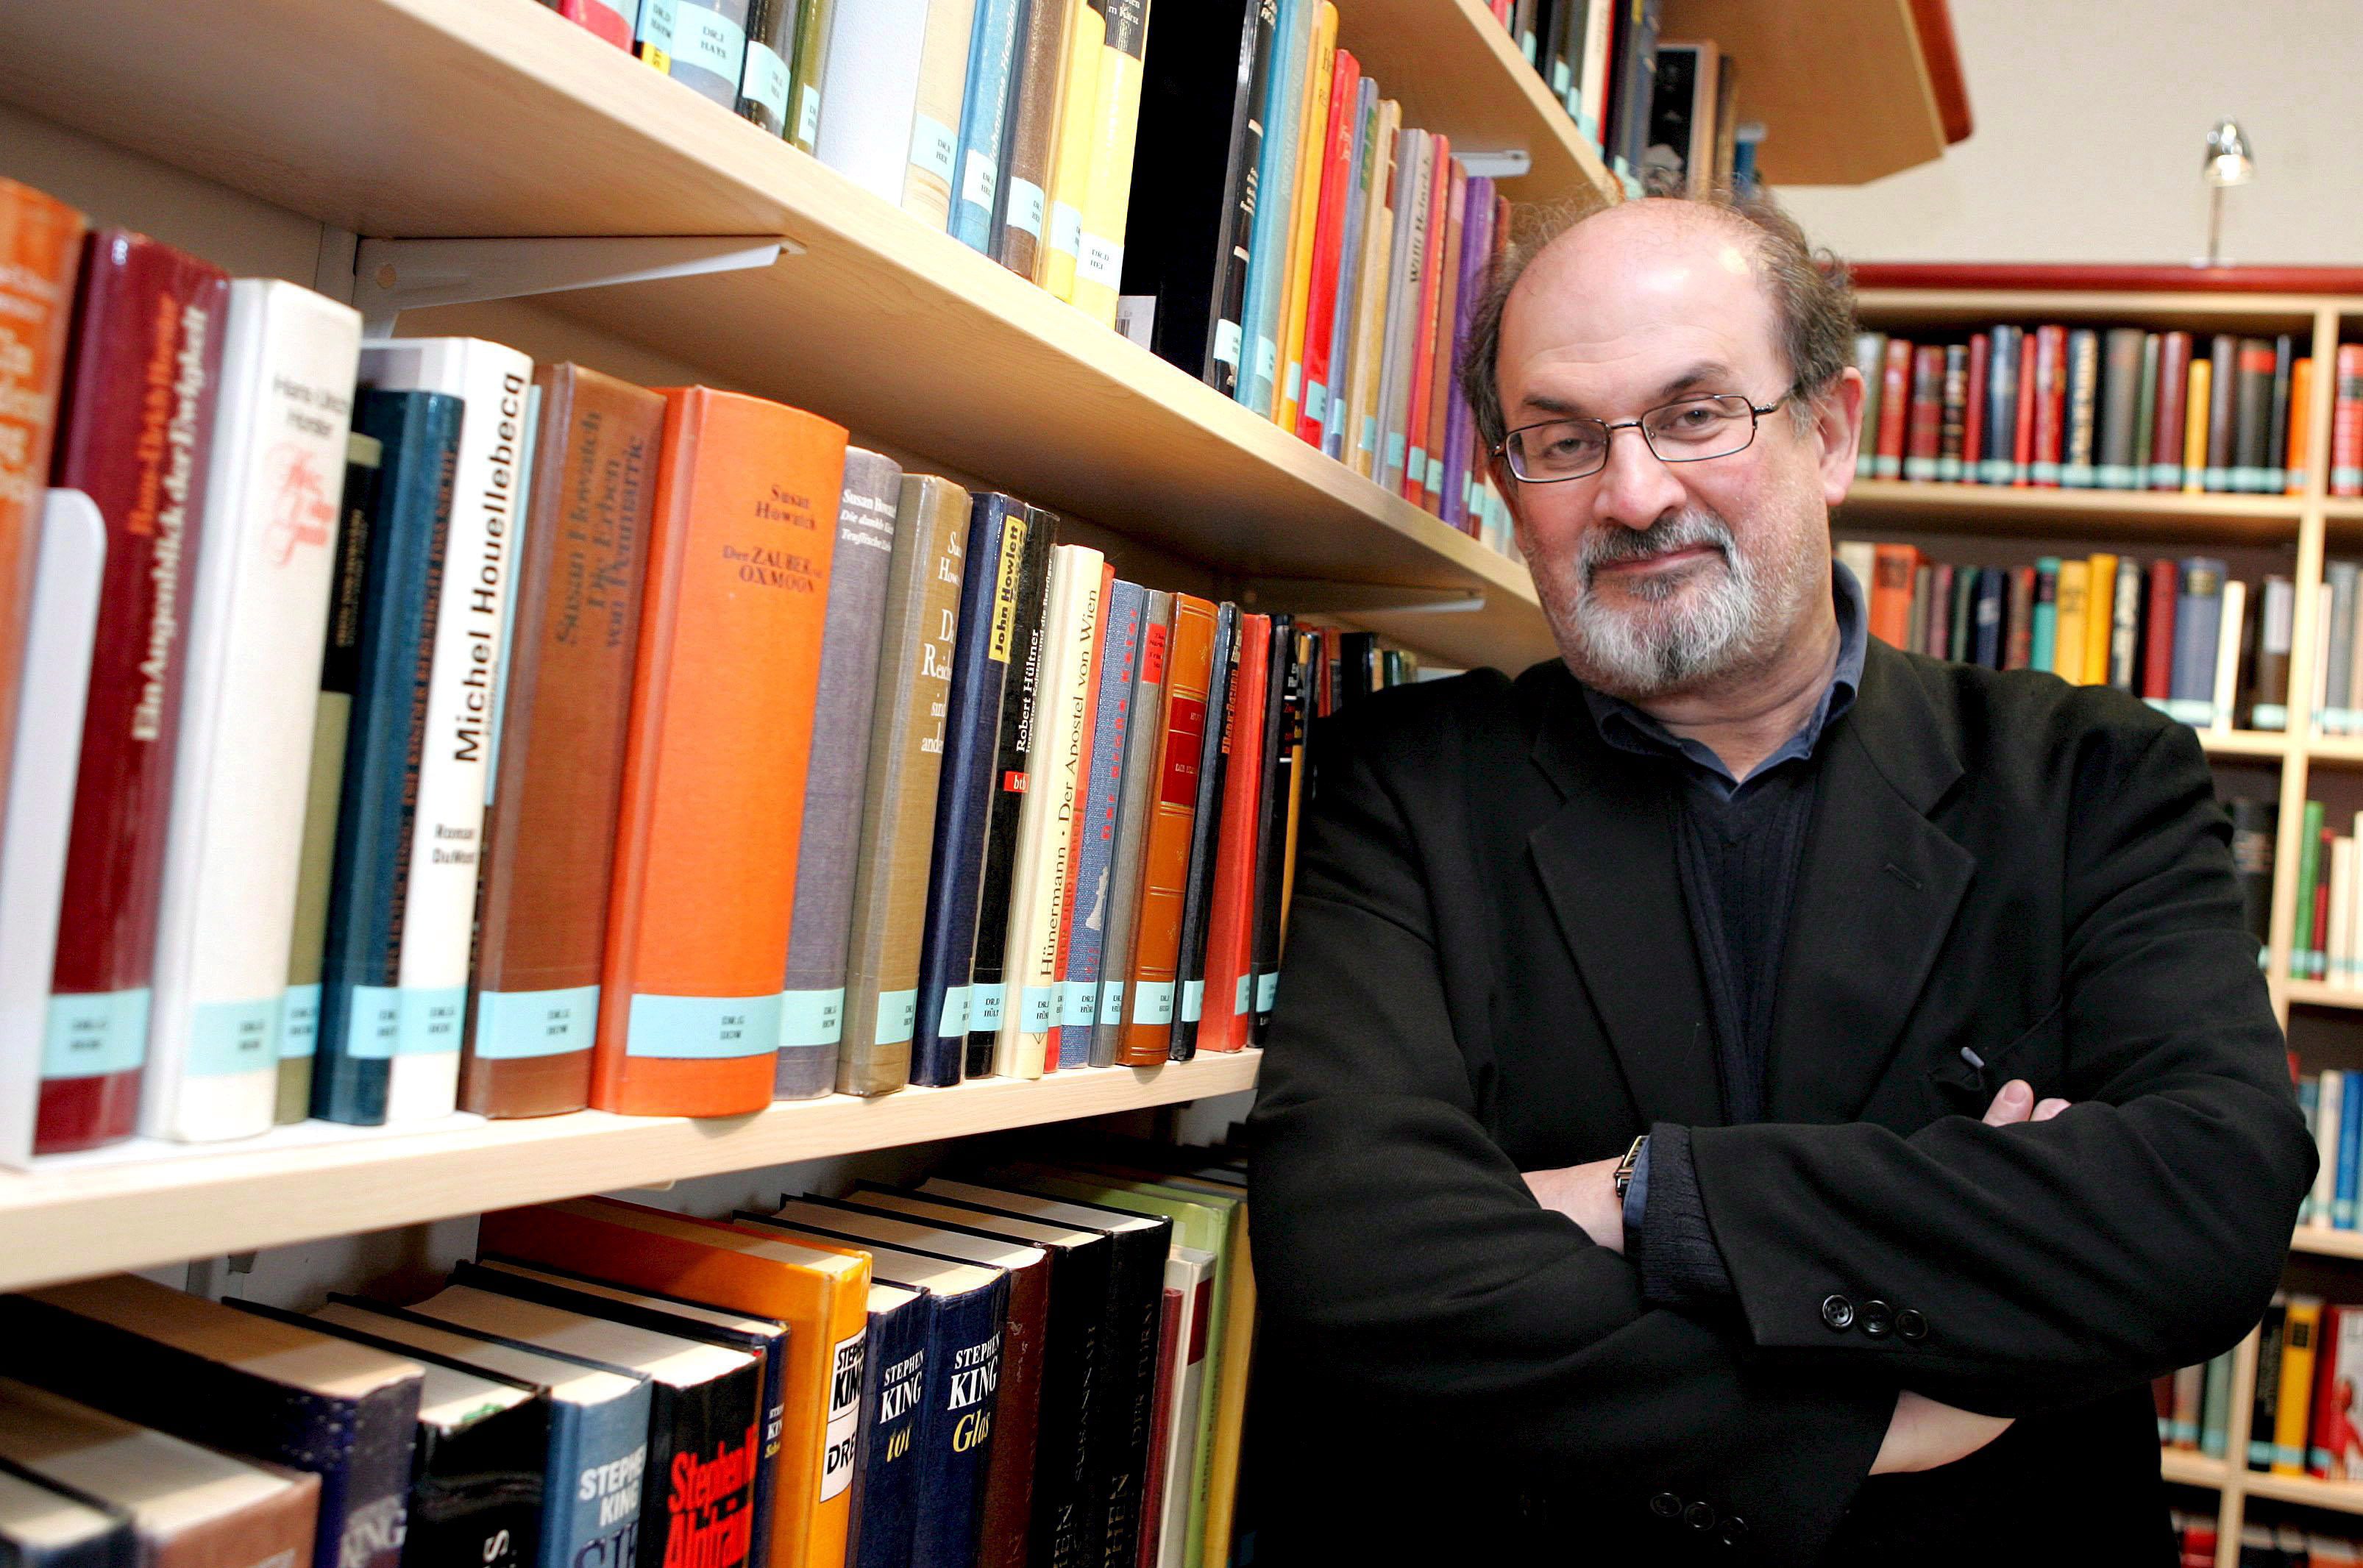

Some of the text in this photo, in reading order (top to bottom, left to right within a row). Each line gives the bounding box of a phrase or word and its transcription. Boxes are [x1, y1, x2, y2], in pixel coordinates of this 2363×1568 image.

[770, 484, 810, 510] Susan
[842, 488, 873, 510] Susan
[454, 371, 525, 763] Michel Houellebecq
[994, 525, 1019, 655] John Howlett
[1080, 589, 1097, 642] Wien
[1015, 628, 1040, 753] Robert Hültner
[1078, 651, 1090, 687] von
[1065, 696, 1084, 774] Apostel
[1013, 775, 1029, 791] btb
[1058, 782, 1073, 824] Der
[1040, 846, 1066, 977] Hünermann
[883, 1347, 925, 1386] STEPHEN
[953, 1330, 1001, 1369] STEPHEN
[878, 1371, 922, 1425] KING
[946, 1355, 998, 1411] KING
[826, 1430, 856, 1475] DRE
[952, 1411, 990, 1453] Glas
[599, 1478, 640, 1528] KING
